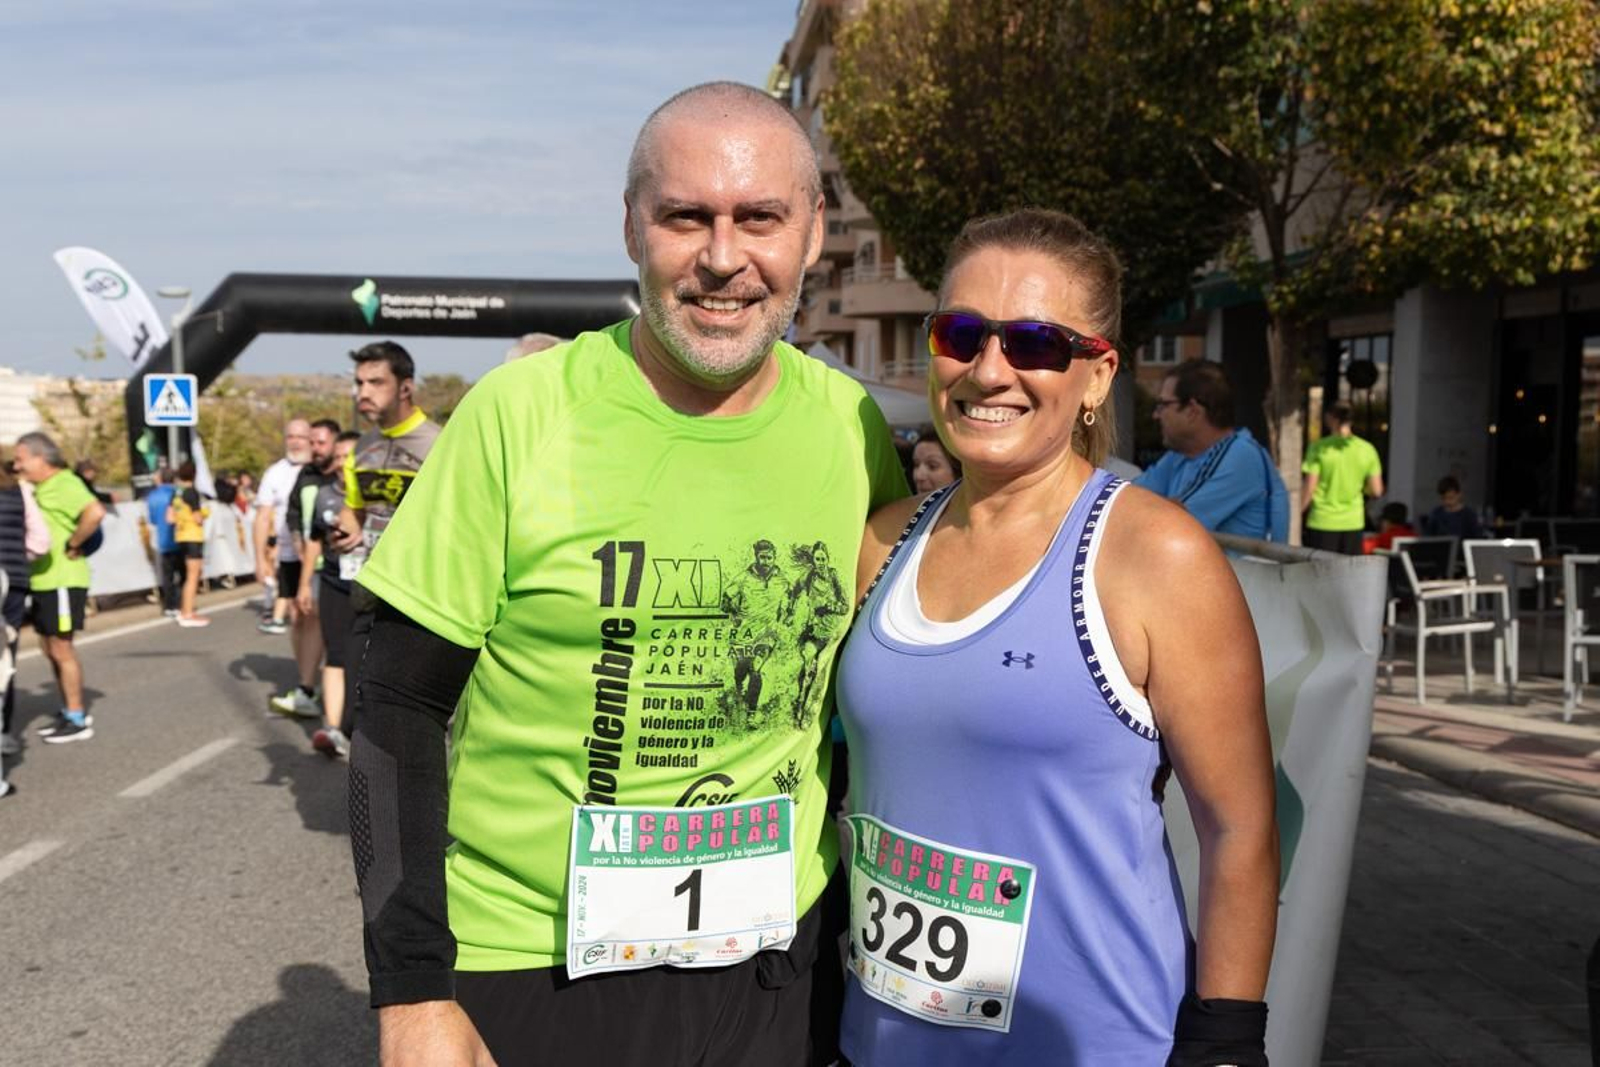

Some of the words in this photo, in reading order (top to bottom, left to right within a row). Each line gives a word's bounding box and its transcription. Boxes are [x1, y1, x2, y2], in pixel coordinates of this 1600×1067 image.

[1079, 499, 1108, 553] UNDER
[592, 541, 645, 608] 17
[652, 559, 721, 608] XI
[1073, 563, 1091, 641] ARMOUR
[651, 628, 753, 640] CARRERA
[649, 645, 753, 657] POPULAR
[646, 660, 703, 675] JAÉN
[1087, 653, 1126, 716] UNDER
[642, 696, 667, 710] por
[670, 696, 683, 710] la
[686, 696, 704, 711] NO
[640, 716, 704, 730] violencia
[708, 716, 725, 729] de
[638, 735, 688, 748] género
[691, 737, 699, 749] y
[701, 735, 714, 747] la
[635, 752, 698, 768] igualdad
[638, 803, 779, 832] CARRERA
[589, 813, 633, 853] XI
[638, 822, 779, 853] POPULAR
[593, 857, 609, 865] por
[612, 856, 621, 864] la
[624, 857, 637, 865] No
[640, 855, 681, 865] violencia
[683, 855, 695, 864] de
[697, 852, 725, 864] género
[727, 851, 733, 859] y
[734, 848, 743, 857] la
[743, 843, 778, 858] igualdad
[880, 832, 1014, 883] CARRERA
[674, 869, 702, 931] 1
[913, 889, 941, 904] género
[943, 899, 949, 908] y
[951, 899, 960, 909] la
[962, 902, 1005, 918] igualdad
[862, 886, 968, 982] 329
